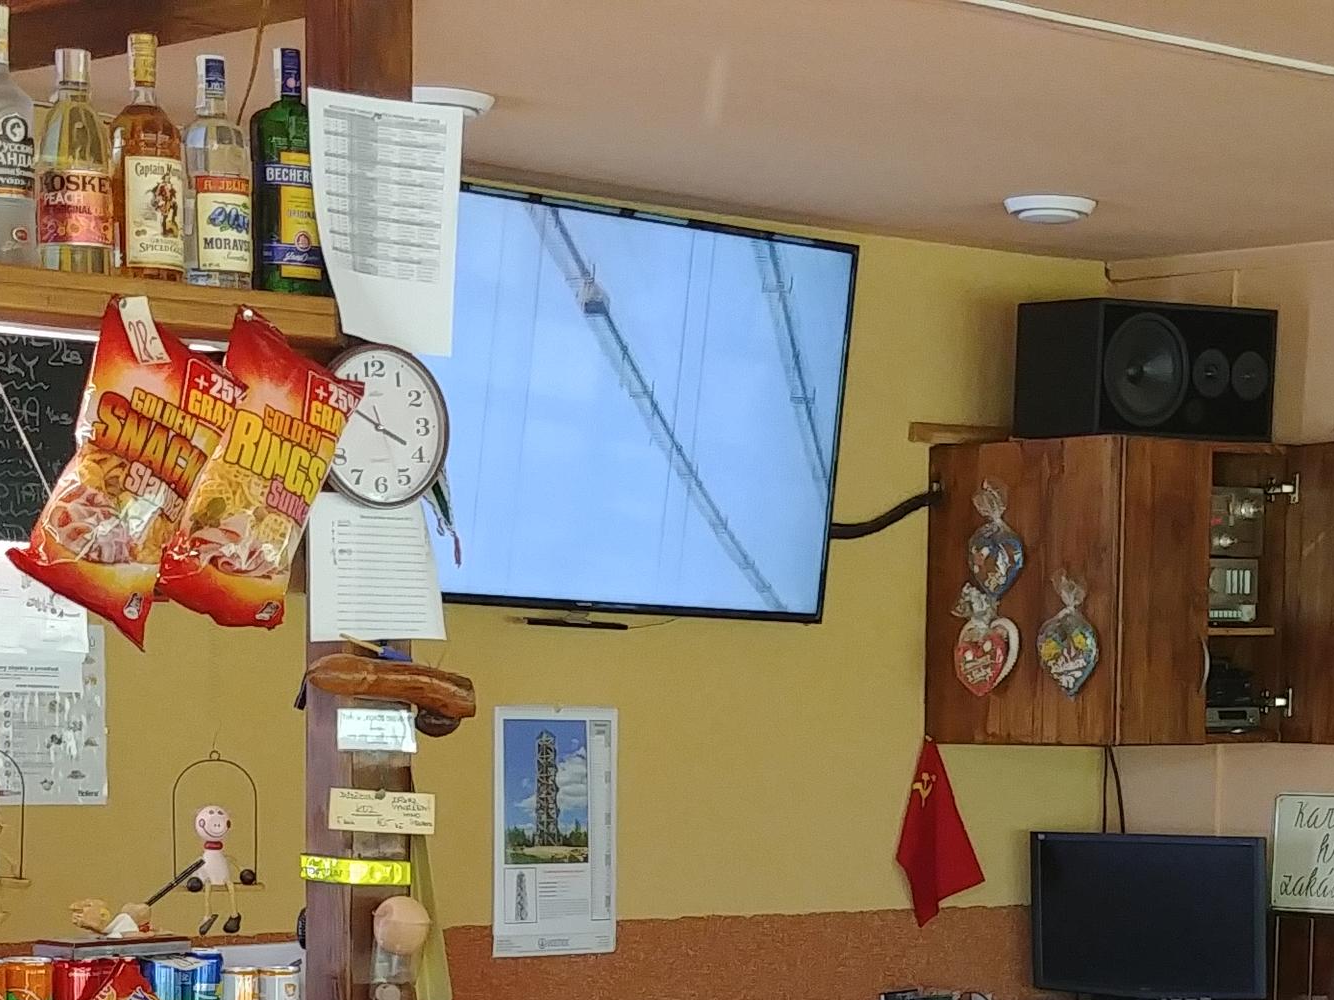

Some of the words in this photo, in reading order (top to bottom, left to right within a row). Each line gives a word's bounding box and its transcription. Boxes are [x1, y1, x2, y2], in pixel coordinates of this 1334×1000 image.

[135, 162, 165, 177] Captain
[203, 236, 250, 254] MORAVS
[363, 360, 386, 378] 12
[396, 371, 402, 388] 1
[408, 390, 423, 408] 2
[131, 386, 199, 442] GOLDEN
[263, 404, 321, 454] GOLDEN
[416, 417, 430, 436] 3
[92, 391, 208, 499] SNACK
[223, 408, 329, 505] RINGS
[333, 447, 348, 466] 8
[411, 446, 426, 463] 4
[351, 468, 364, 486] 7
[374, 476, 389, 494] 6
[397, 468, 412, 487] 5
